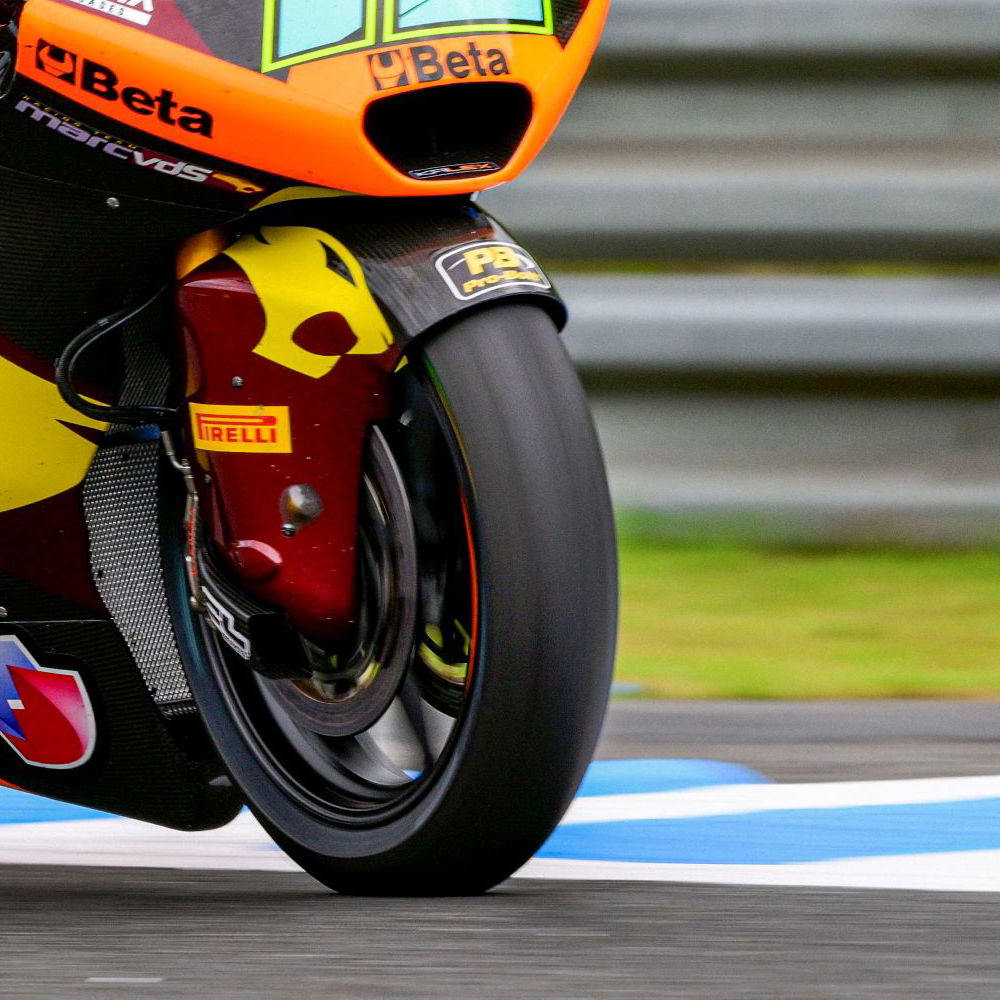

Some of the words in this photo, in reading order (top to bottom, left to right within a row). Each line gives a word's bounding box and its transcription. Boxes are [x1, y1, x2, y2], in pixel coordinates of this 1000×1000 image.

[410, 41, 511, 83] Beta
[22, 94, 82, 128] RACING
[80, 58, 214, 140] Beta
[462, 246, 521, 276] PB
[195, 412, 277, 443] PIRELLI
